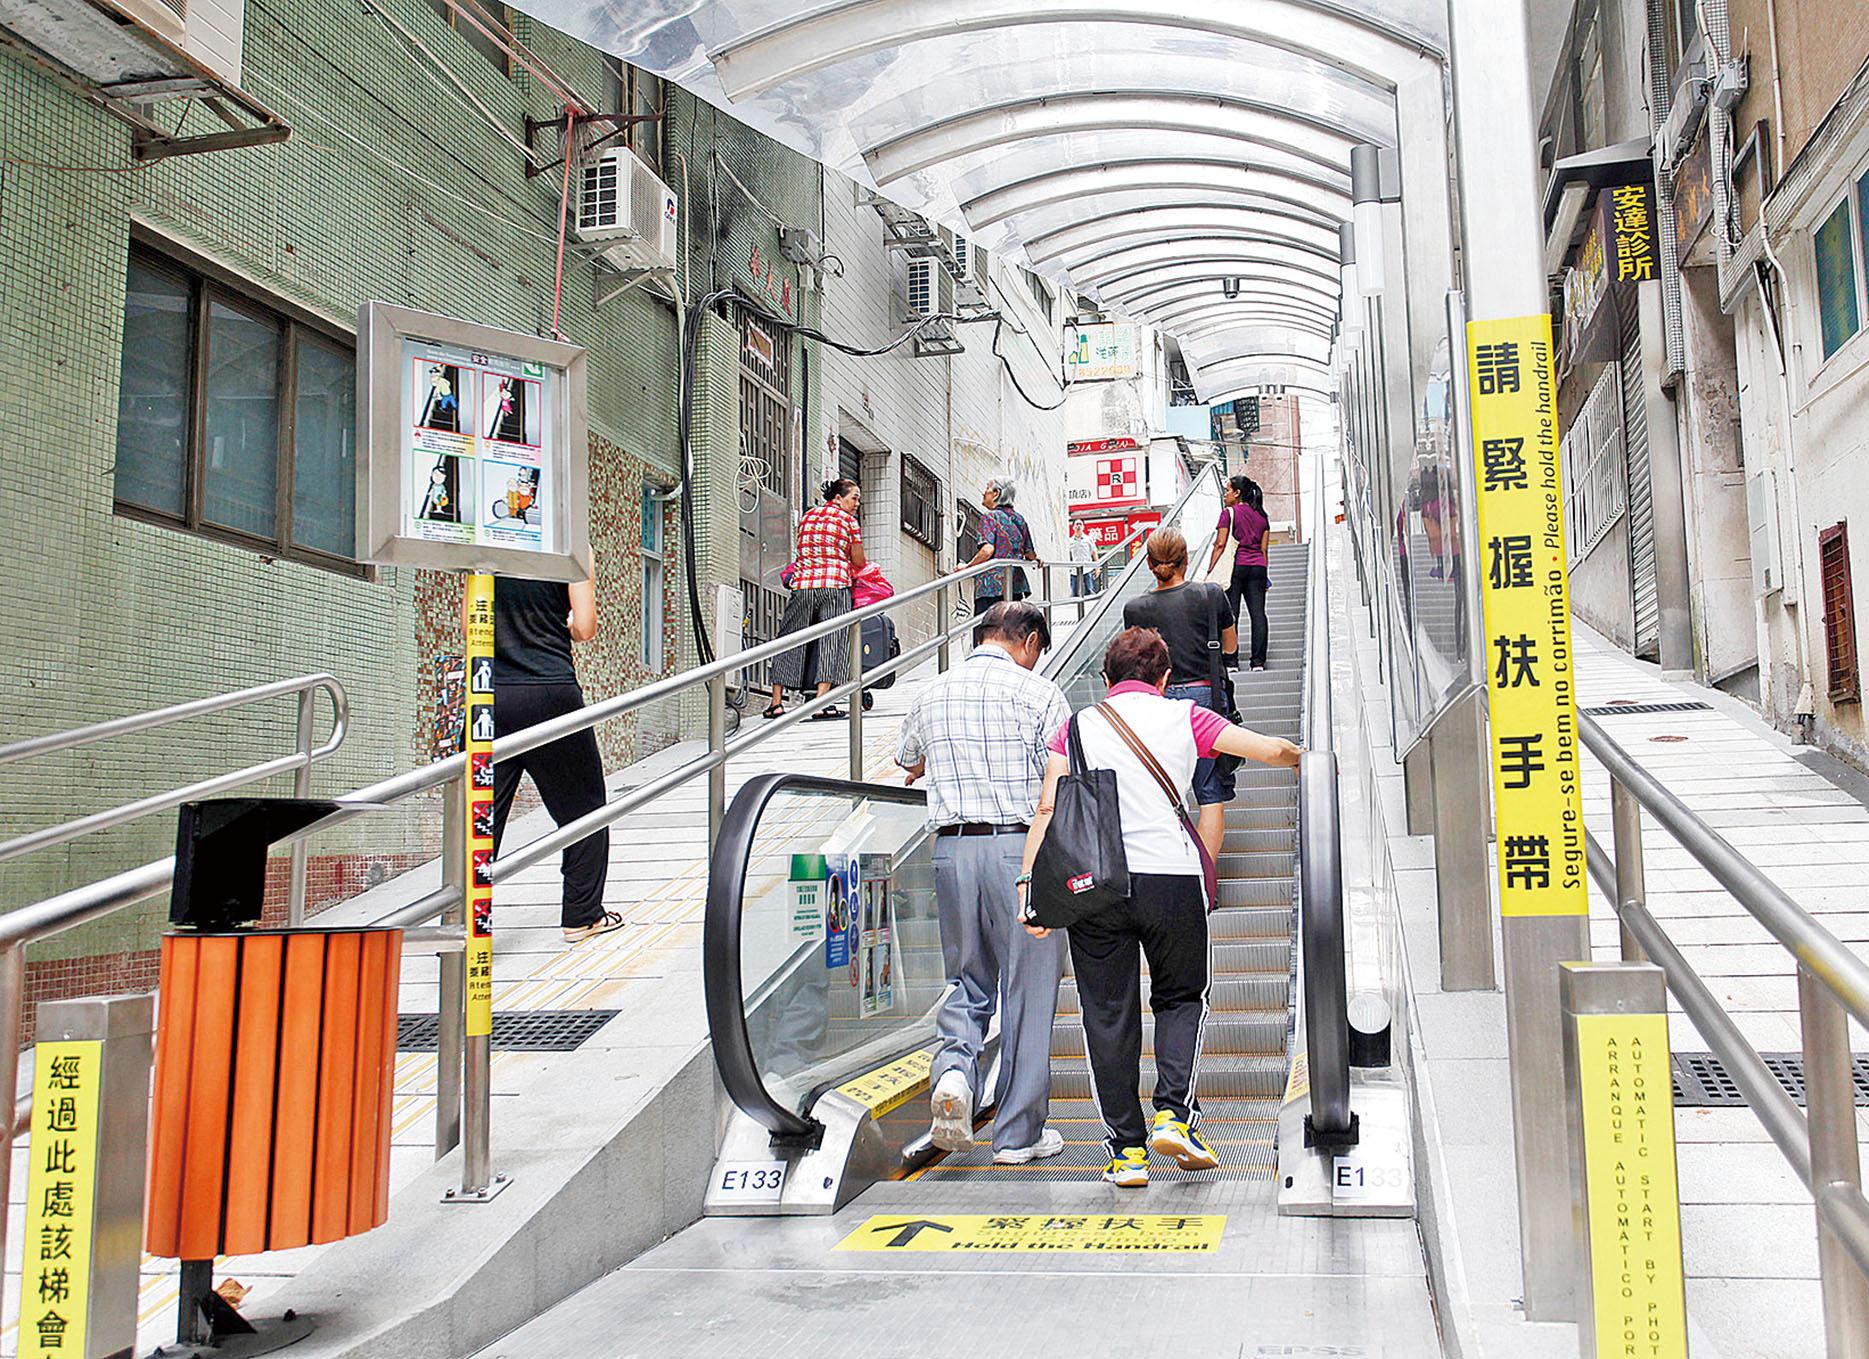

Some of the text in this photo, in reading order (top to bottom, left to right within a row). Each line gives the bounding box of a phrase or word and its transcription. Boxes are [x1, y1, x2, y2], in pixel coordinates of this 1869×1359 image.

[1612, 185, 1654, 282] 安達診所
[1111, 473, 1122, 484] R
[1476, 341, 1550, 890] 請緊握扶手帶
[1530, 341, 1584, 889] Segure-se bem no corrimão Please hold the handrail
[1631, 1036, 1649, 1158] AUTOMATIC
[37, 1056, 81, 1359] 經過此處該梯會
[721, 1169, 782, 1190] E133
[1336, 1166, 1402, 1188] E133
[1607, 1036, 1636, 1356] ARRANQUE AUTOMATICO POR
[1641, 1174, 1653, 1242] START
[982, 1217, 1203, 1230] 緊握扶手
[1083, 1242, 1209, 1250] Handrail
[1645, 1259, 1656, 1284] BY
